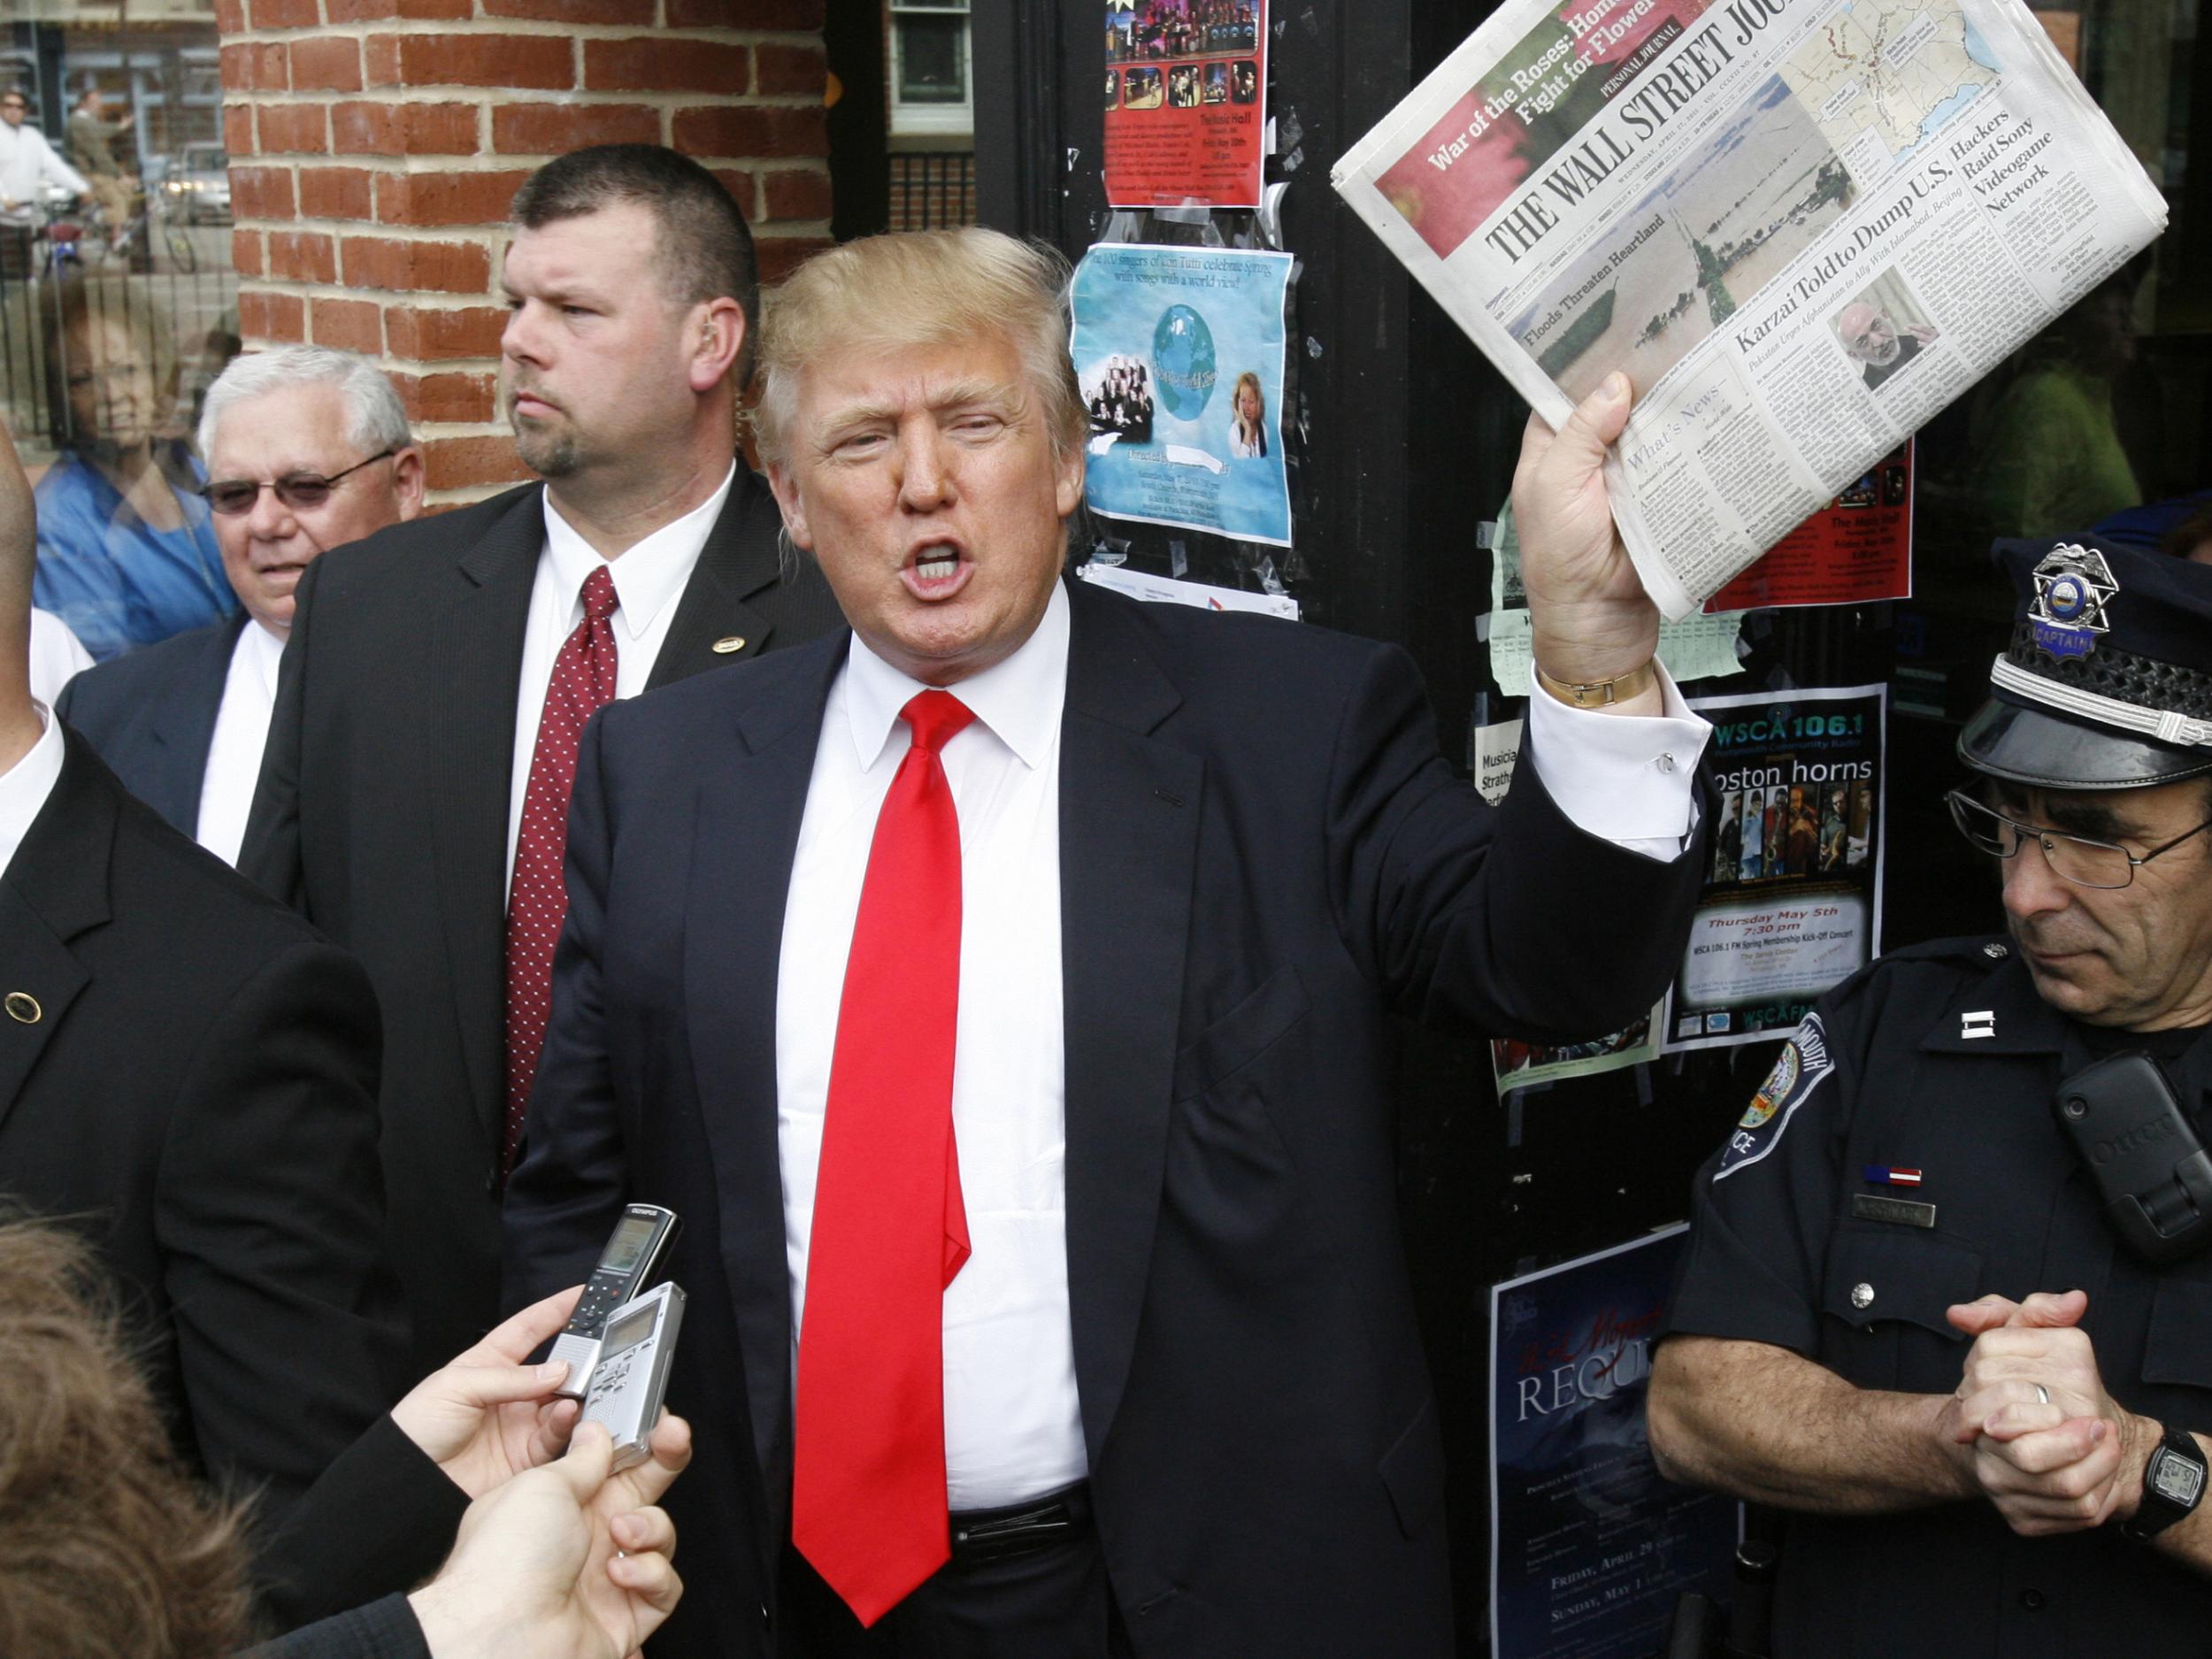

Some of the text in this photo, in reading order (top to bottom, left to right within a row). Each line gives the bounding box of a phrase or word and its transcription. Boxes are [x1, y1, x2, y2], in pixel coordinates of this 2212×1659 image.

[1428, 0, 1623, 172] War of the Roses: Hom
[1515, 73, 1569, 125] Fight
[1564, 50, 1594, 82] for
[1600, 58, 1645, 98] PERSONAL
[1485, 191, 1560, 265] THE
[1541, 126, 1635, 208] WALL
[1619, 22, 1735, 142] STREET
[1949, 109, 2009, 161] Hackers
[1961, 116, 2034, 180] Raid Sony
[1973, 131, 2054, 198] Videogame
[1985, 163, 2050, 219] Network
[1150, 254, 1161, 266] of
[1735, 293, 1799, 354] Karzai
[1792, 255, 1840, 301] Told
[1835, 245, 1857, 269] to
[1852, 196, 1913, 251] Dump
[1908, 158, 1953, 199] U.S.
[1748, 342, 1781, 372] Pakistan
[1780, 325, 1802, 348] Urges
[1801, 288, 1846, 328] Afghanistan
[1845, 275, 1855, 291] to
[1855, 264, 1871, 285] Ally
[1870, 248, 1891, 269] With
[1932, 186, 1963, 214] Beijing
[1524, 214, 1665, 348] Floods Threaten Heartland
[1627, 422, 1681, 469] What's
[2034, 628, 2089, 650] CAPTAIN
[1715, 713, 1864, 747] WSCA 106.1
[1483, 749, 1517, 769] Musicia
[1715, 759, 1872, 791] oston horns
[1709, 906, 1838, 928] Thursday May 5th
[1744, 922, 1801, 936] 7:30 pm
[1742, 940, 1762, 951] Spring
[1795, 1025, 1829, 1072] MOUTH
[1517, 1337, 1652, 1422] REQU
[1551, 1565, 1597, 1590] FRIDAY,
[1600, 1550, 1635, 1571] APRIL
[1551, 1599, 1600, 1624] SUNDAY,
[1603, 1584, 1631, 1601] MAY
